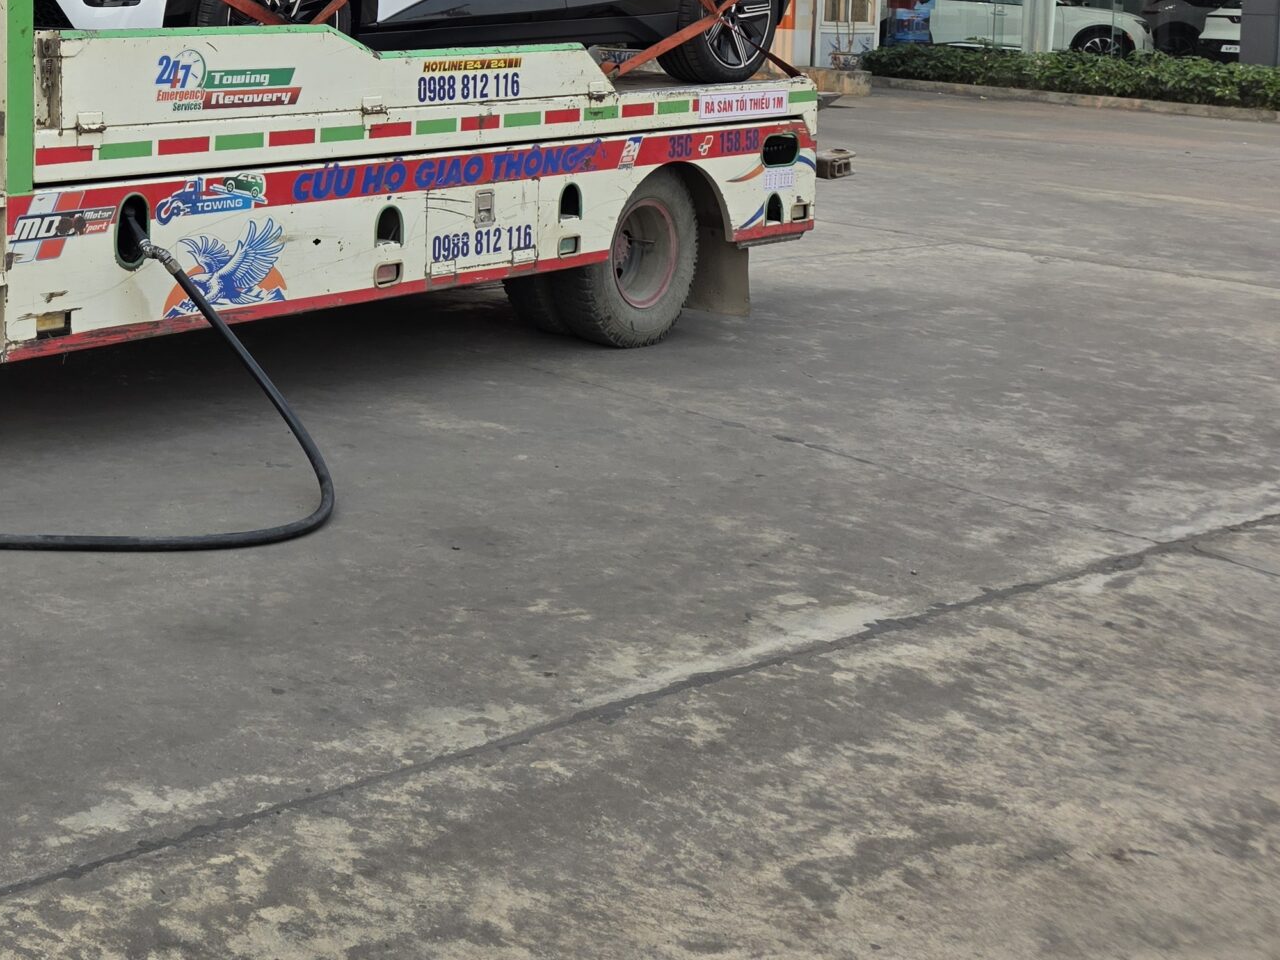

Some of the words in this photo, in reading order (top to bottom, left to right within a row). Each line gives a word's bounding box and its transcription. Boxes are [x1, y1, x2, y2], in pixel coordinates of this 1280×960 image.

[423, 60, 463, 73] HOTLINE
[211, 71, 270, 85] Towing
[418, 74, 456, 103] 0988
[461, 73, 489, 100] 812
[493, 72, 520, 98] 116
[156, 89, 206, 102] Emergency
[210, 91, 292, 105] Recovery
[172, 101, 202, 111] Services
[668, 134, 693, 158] 35C
[720, 129, 760, 152] 158.58
[292, 161, 355, 203] CỨU
[361, 156, 407, 194] HỘ
[414, 155, 485, 189] GIAO
[491, 144, 579, 180] THÔNG
[196, 199, 244, 212] TOWING
[83, 221, 108, 234] port
[432, 232, 470, 262] 0988
[474, 227, 502, 255] 812
[507, 224, 532, 251] 116
